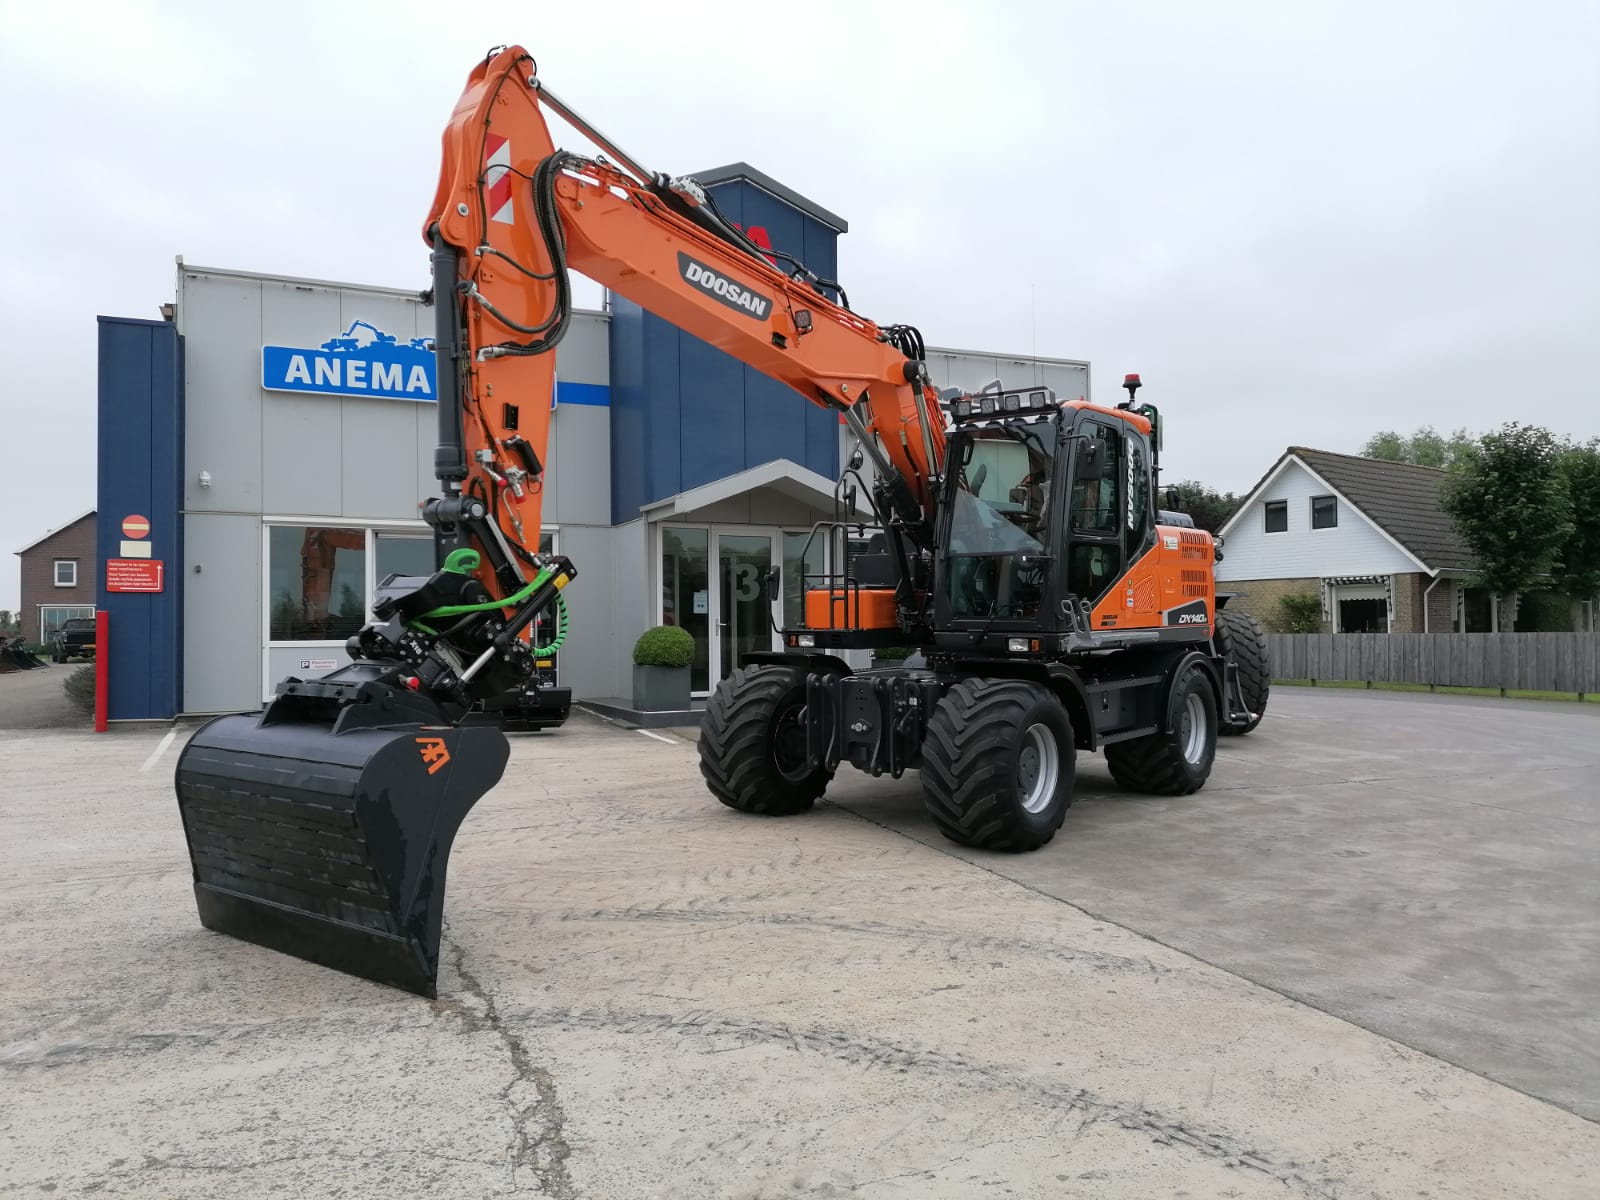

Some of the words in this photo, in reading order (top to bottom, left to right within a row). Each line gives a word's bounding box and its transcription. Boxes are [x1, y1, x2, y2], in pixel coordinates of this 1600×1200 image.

[685, 262, 767, 316] DOOSAN
[284, 355, 431, 394] ANEMA
[735, 563, 760, 602] 3
